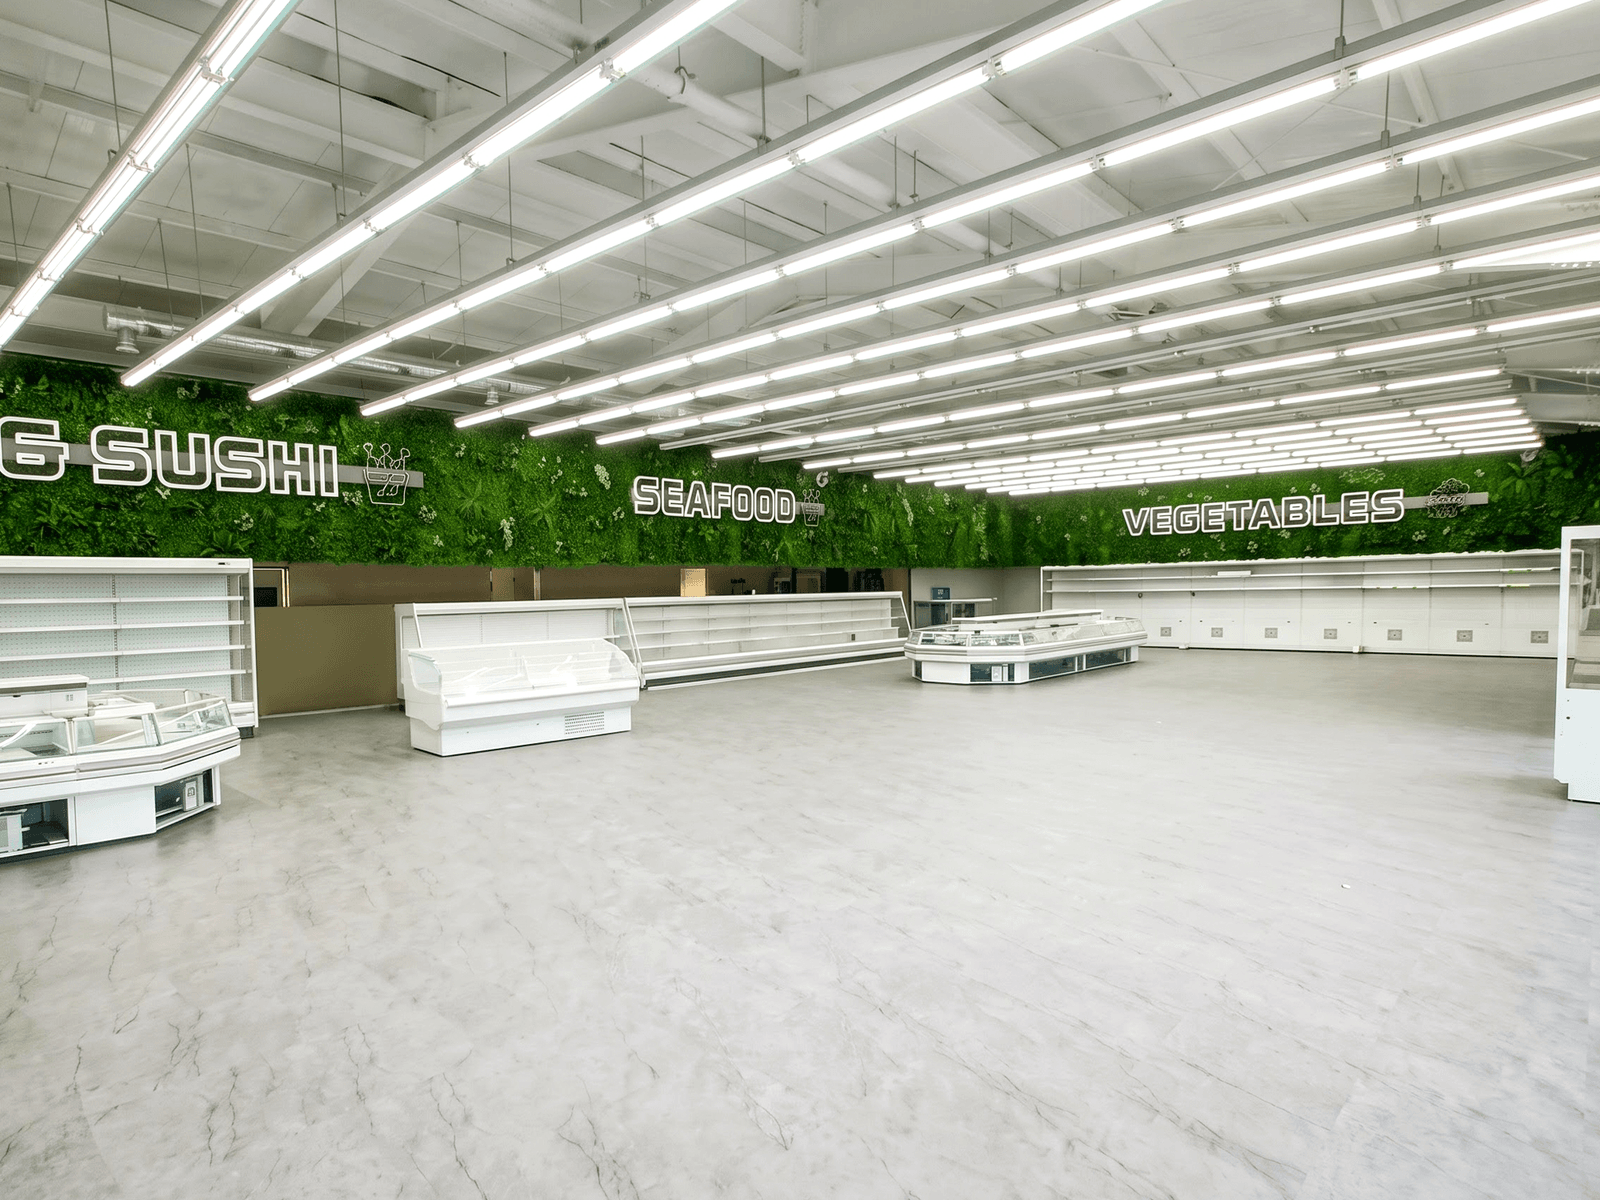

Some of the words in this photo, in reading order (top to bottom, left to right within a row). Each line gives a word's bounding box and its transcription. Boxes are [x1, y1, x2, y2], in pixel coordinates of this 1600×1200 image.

[90, 424, 339, 498] SUSHI
[633, 475, 796, 524] SEAFOOD
[1122, 488, 1405, 536] VEGETABLES
